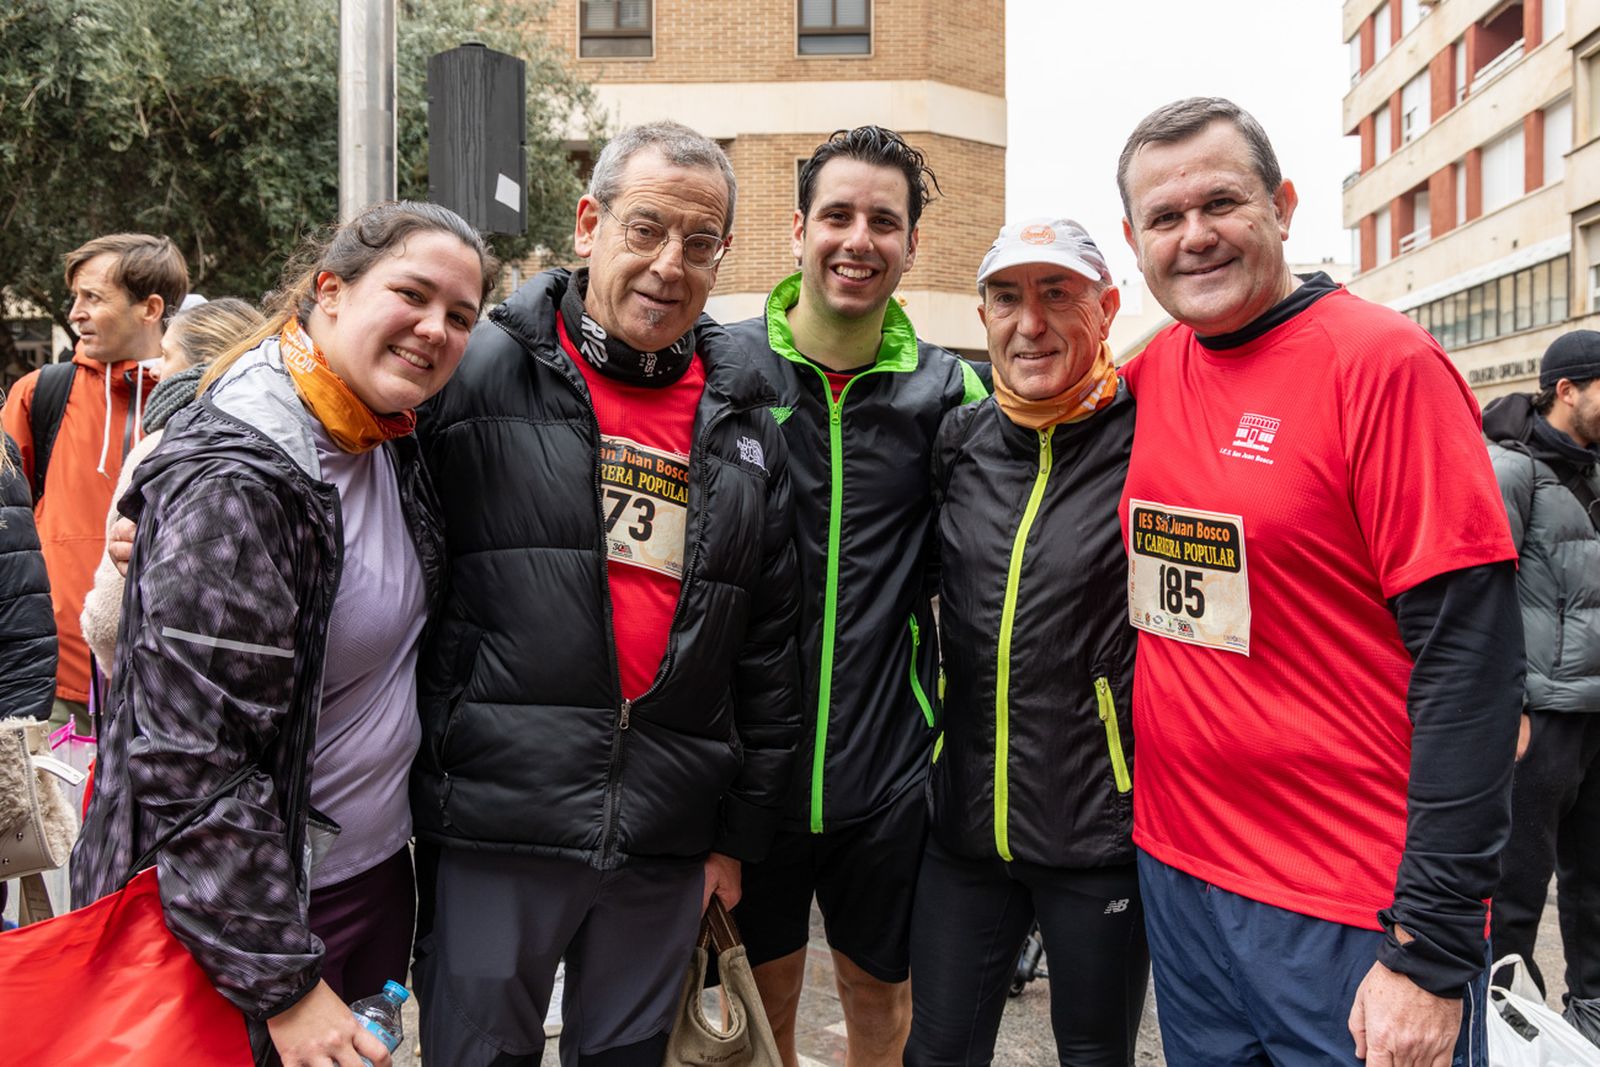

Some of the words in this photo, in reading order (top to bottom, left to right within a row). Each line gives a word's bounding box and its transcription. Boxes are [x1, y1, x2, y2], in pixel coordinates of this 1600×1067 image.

[620, 447, 653, 470] Juan
[1232, 450, 1242, 458] San
[1242, 452, 1255, 460] Juan
[1255, 455, 1274, 465] Bosco
[602, 488, 656, 542] 73
[1138, 512, 1153, 530] IES
[1155, 515, 1169, 533] San
[1170, 517, 1194, 537] Juan
[1197, 521, 1230, 542] Bosco
[1136, 531, 1143, 550] V
[1184, 542, 1236, 568] POPULAR
[1159, 564, 1206, 619] 185
